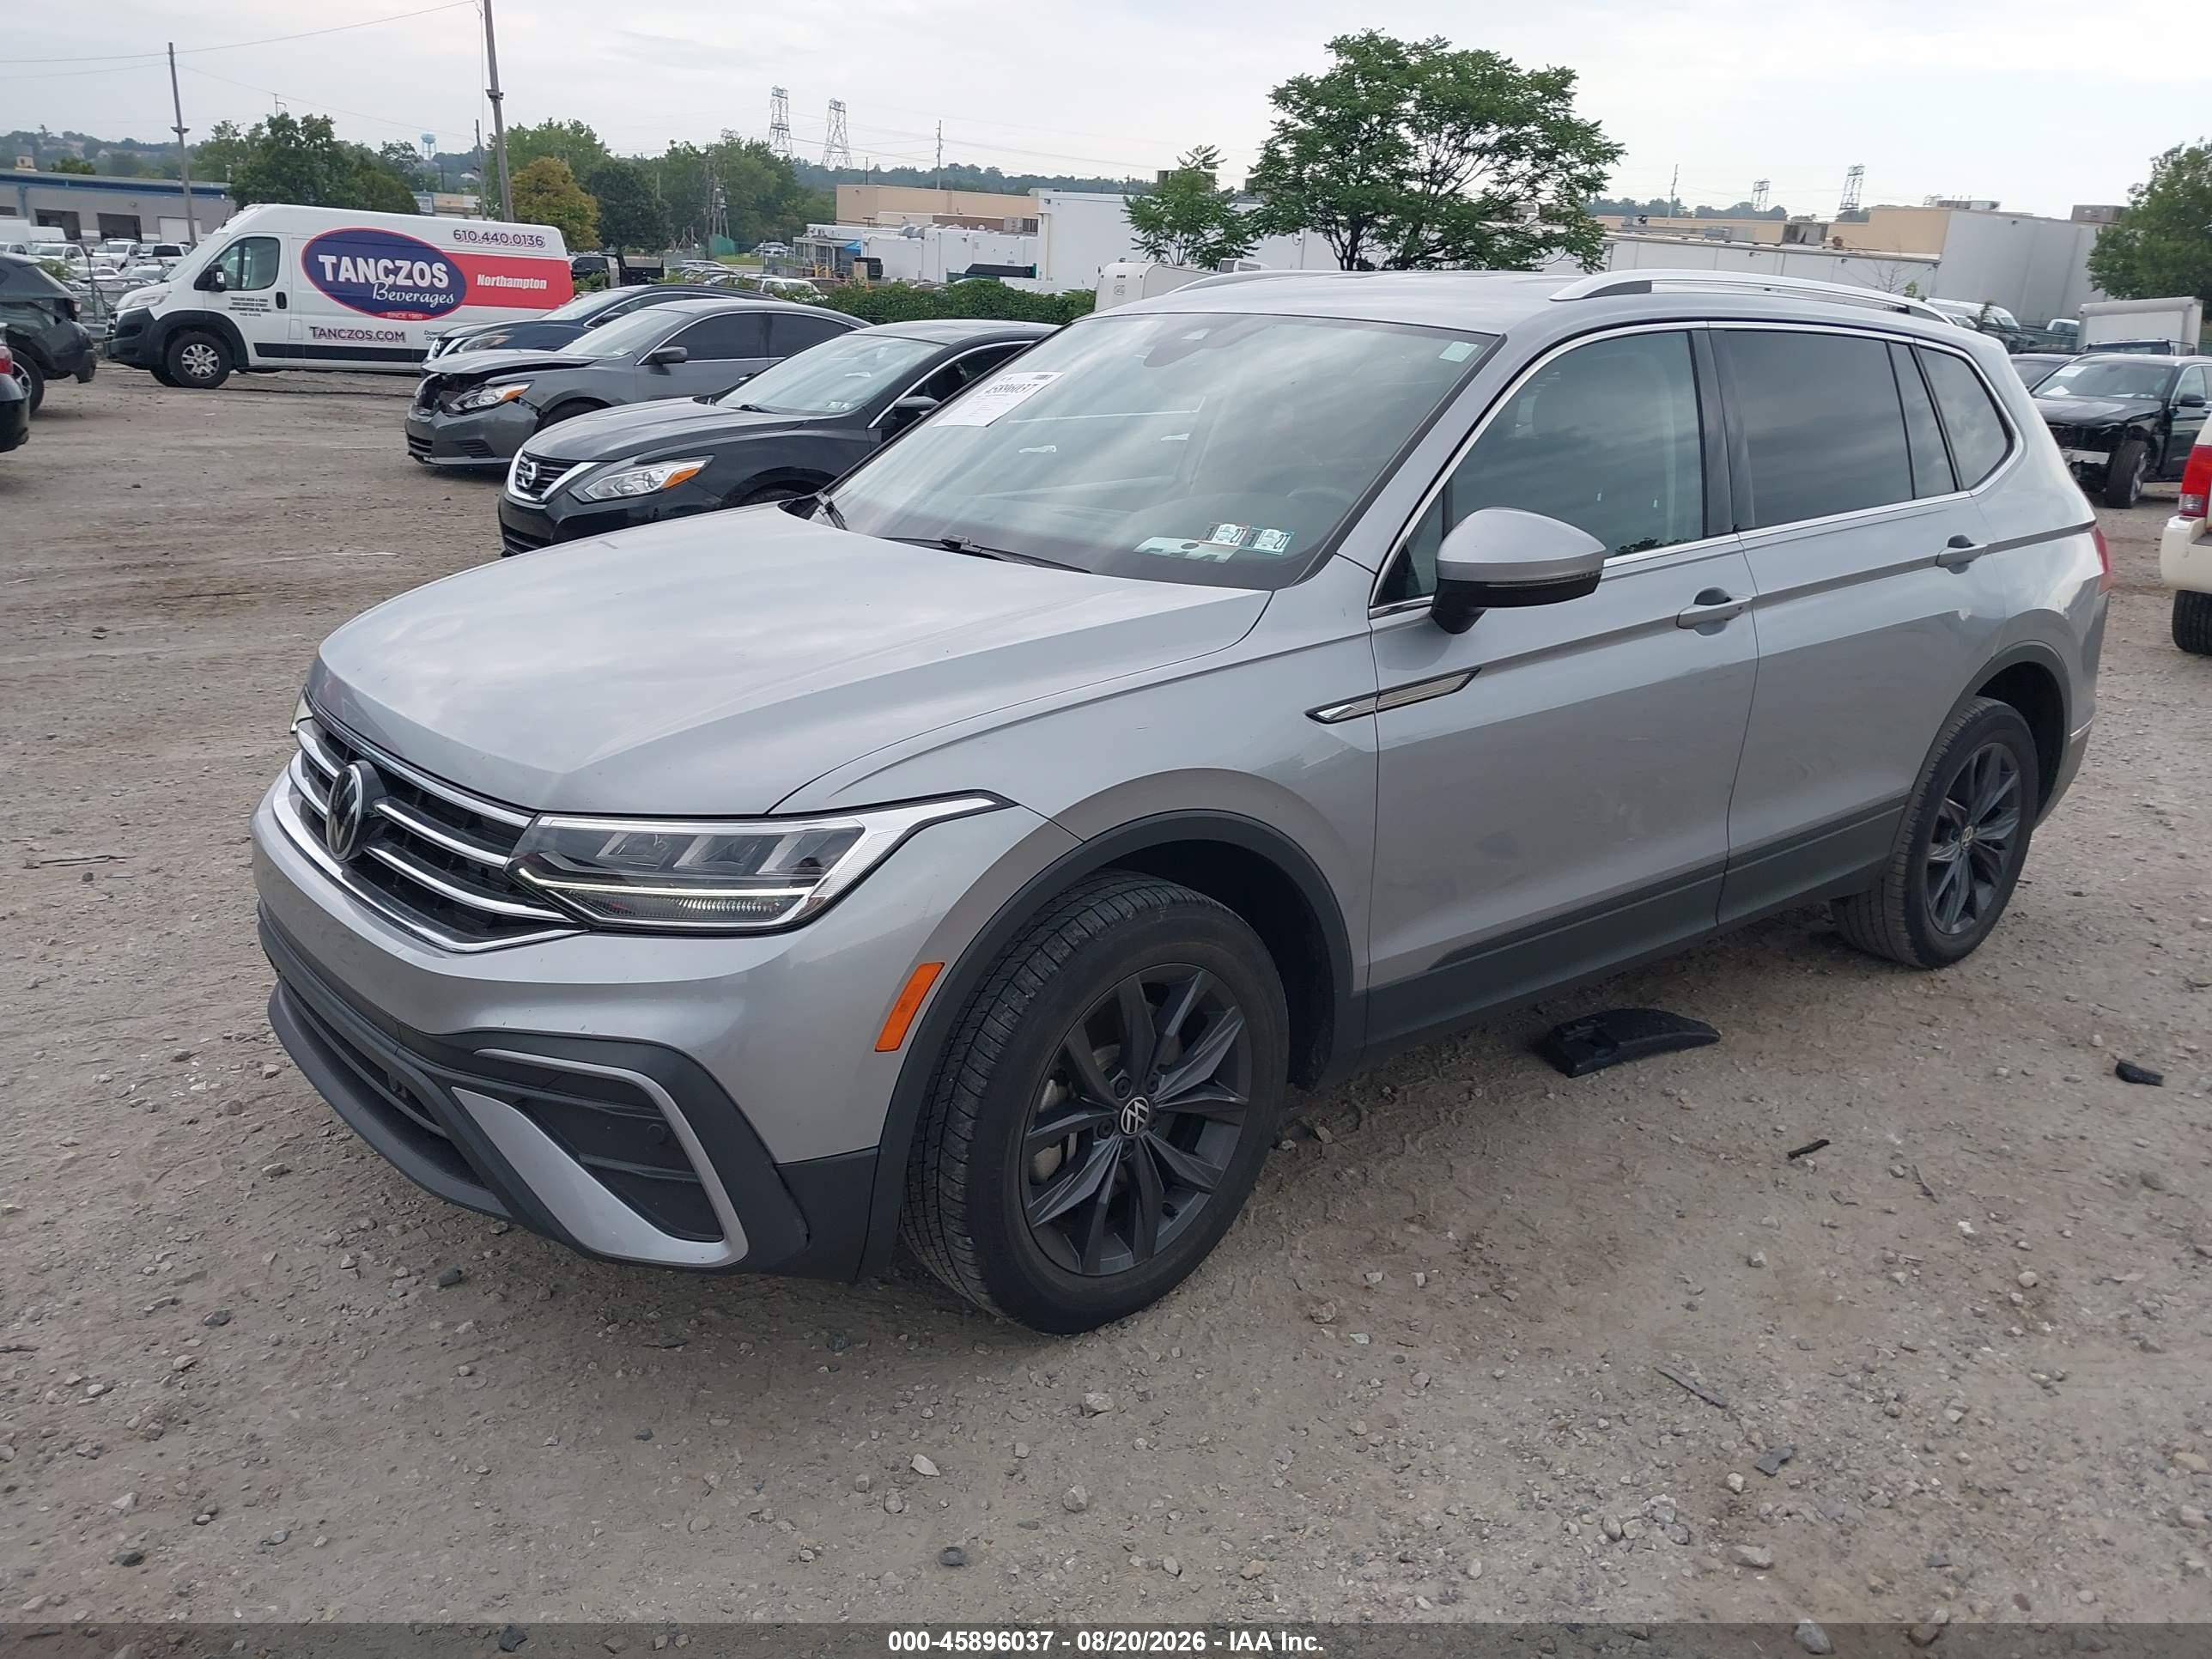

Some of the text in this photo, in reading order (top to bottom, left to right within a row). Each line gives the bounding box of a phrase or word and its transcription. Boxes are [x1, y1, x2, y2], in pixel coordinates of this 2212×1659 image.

[453, 229, 546, 248] 610.440.0136
[318, 254, 449, 289] TANCZOS
[477, 274, 548, 289] Northampton
[372, 281, 454, 307] Beverages
[309, 327, 406, 343] TANCZOS.COM
